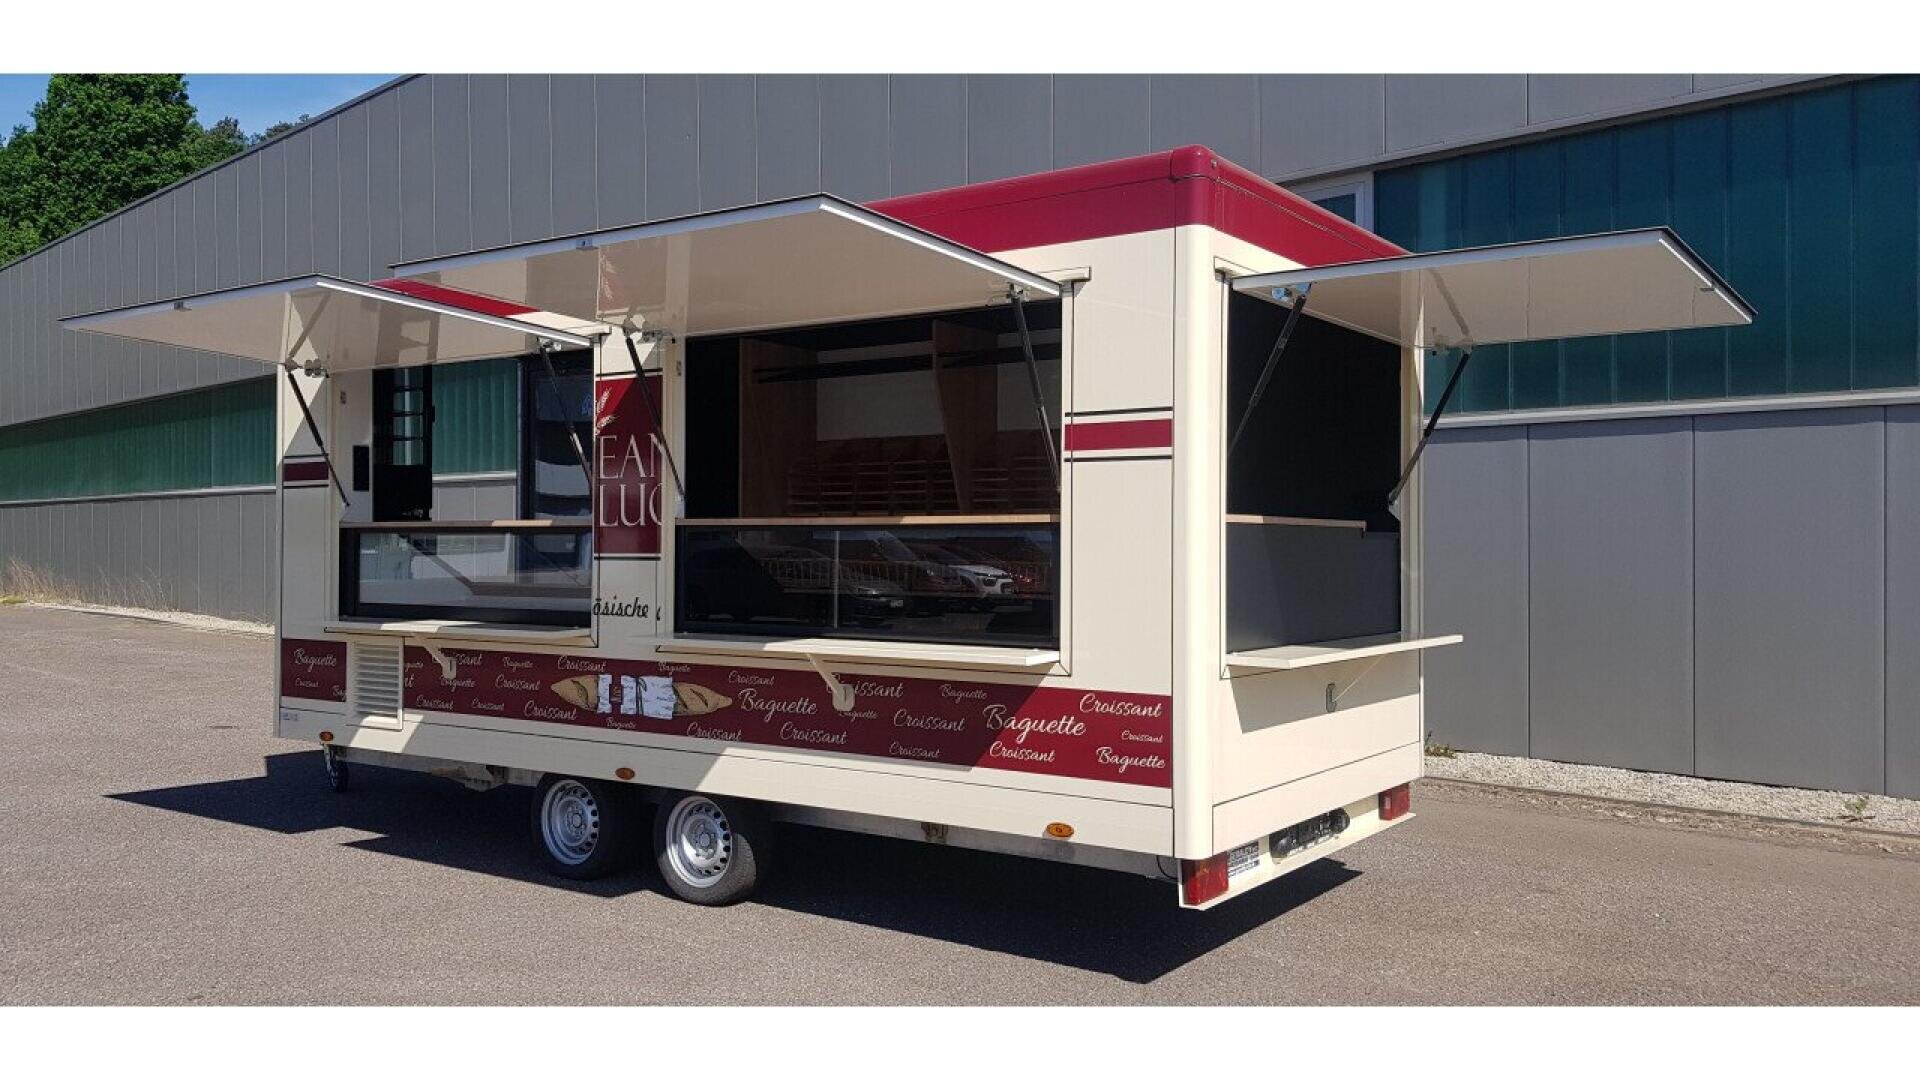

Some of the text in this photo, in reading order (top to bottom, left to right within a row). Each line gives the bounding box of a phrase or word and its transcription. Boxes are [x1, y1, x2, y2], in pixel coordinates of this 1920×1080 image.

[599, 432, 664, 478] EAN
[293, 647, 337, 672] Baguette
[494, 674, 541, 692] Croissant
[728, 671, 775, 686] Croissant
[738, 688, 818, 722] Baguette
[939, 683, 988, 704] Baguette
[1079, 692, 1162, 718] Croissant
[524, 699, 578, 720] Croissant
[893, 708, 966, 732] Croissant
[686, 721, 743, 742] Croissant
[779, 720, 848, 745] Croissant
[982, 704, 1087, 744] Baguette
[1121, 729, 1164, 744] Croissant
[888, 740, 941, 759] Croissant
[989, 740, 1056, 763] Croissant
[1096, 746, 1166, 773] Baguette
